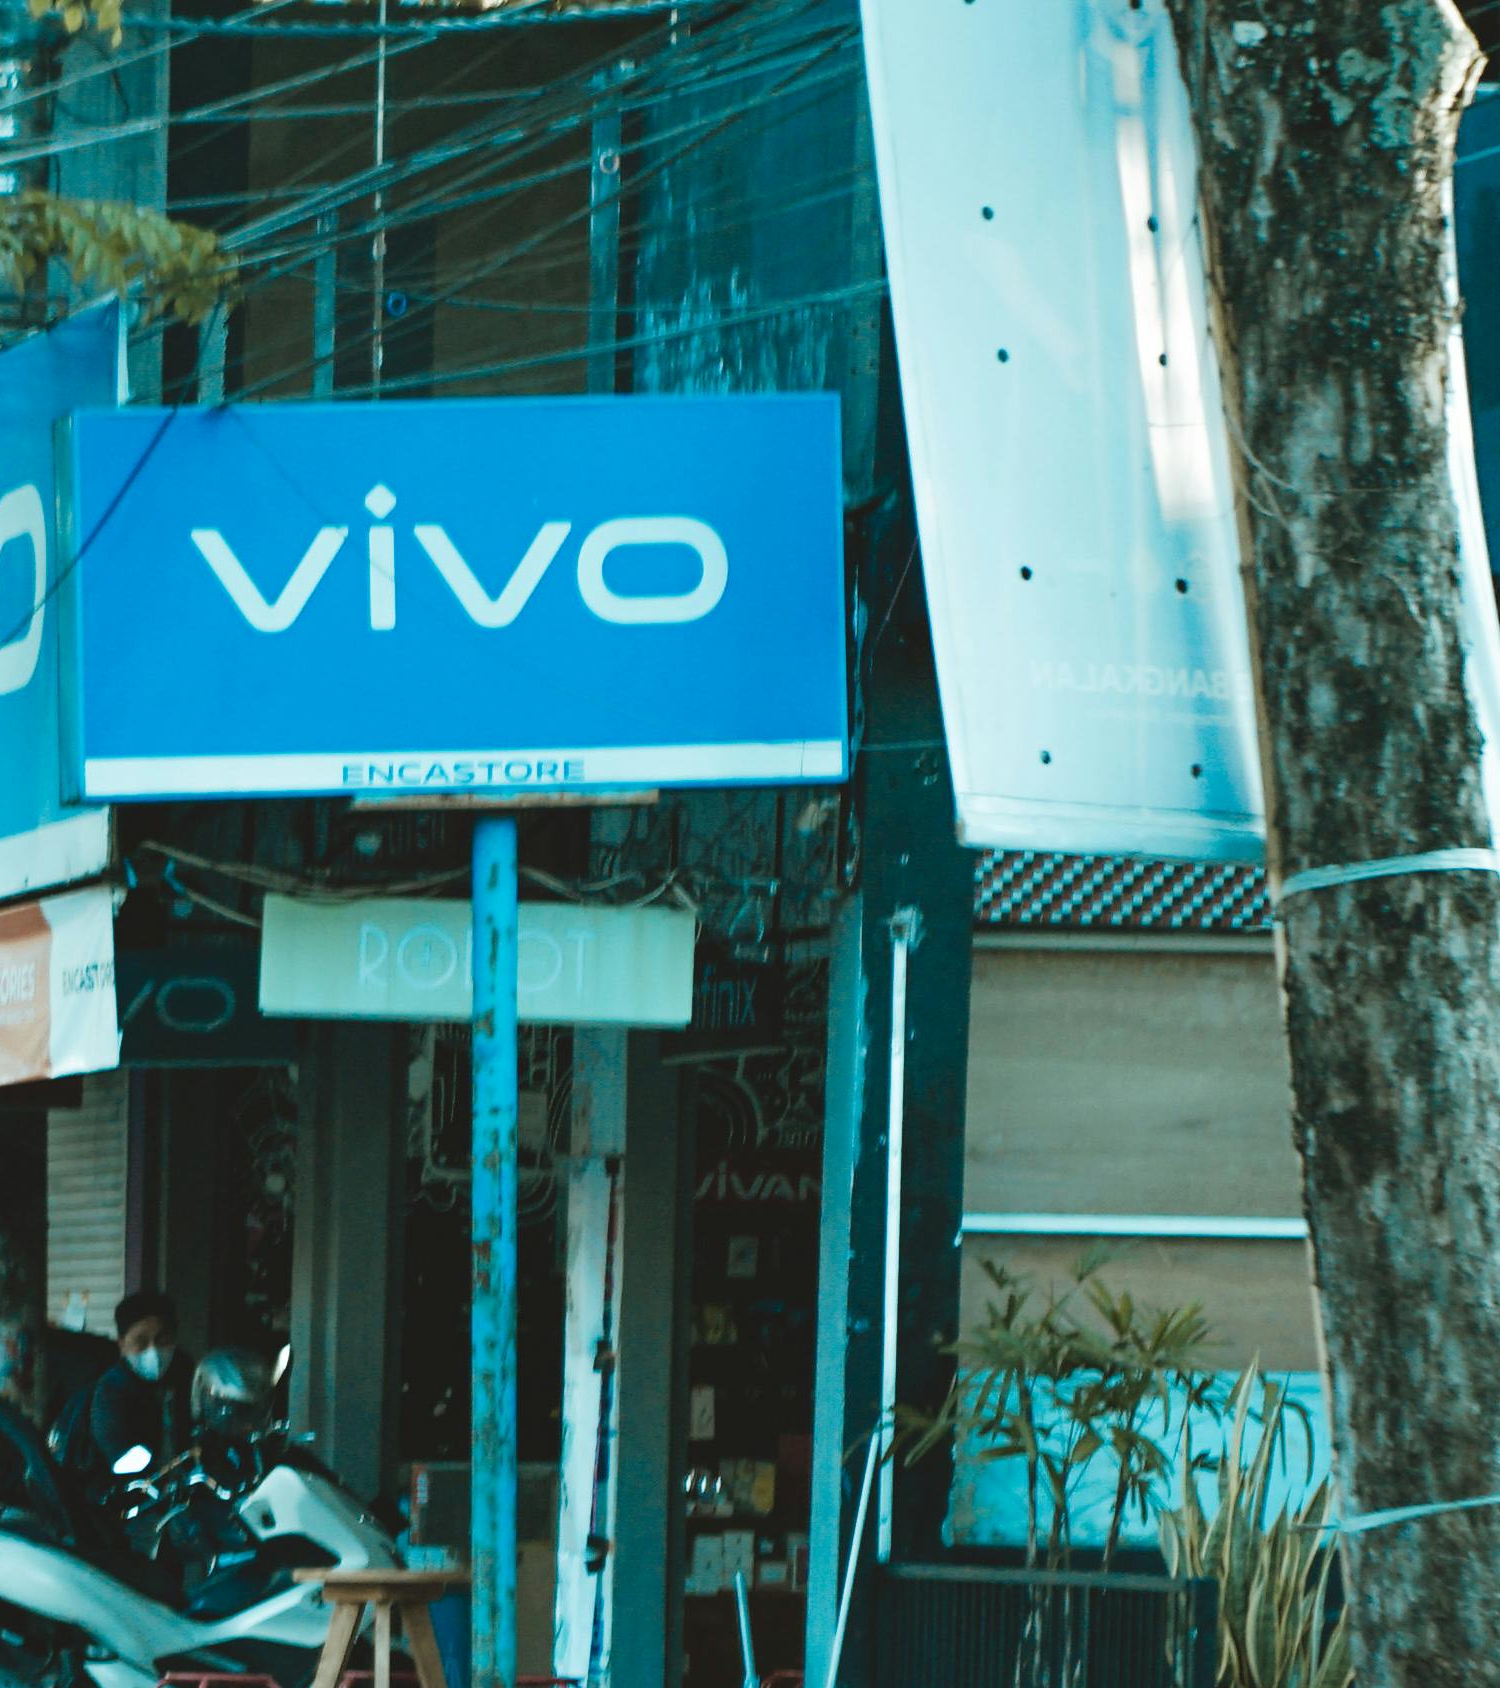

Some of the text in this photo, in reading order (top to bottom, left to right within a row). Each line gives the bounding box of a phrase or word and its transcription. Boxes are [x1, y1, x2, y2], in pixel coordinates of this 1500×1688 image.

[190, 483, 729, 633] vivo
[342, 760, 585, 785] ENCASTORE
[358, 925, 596, 992] ROOT
